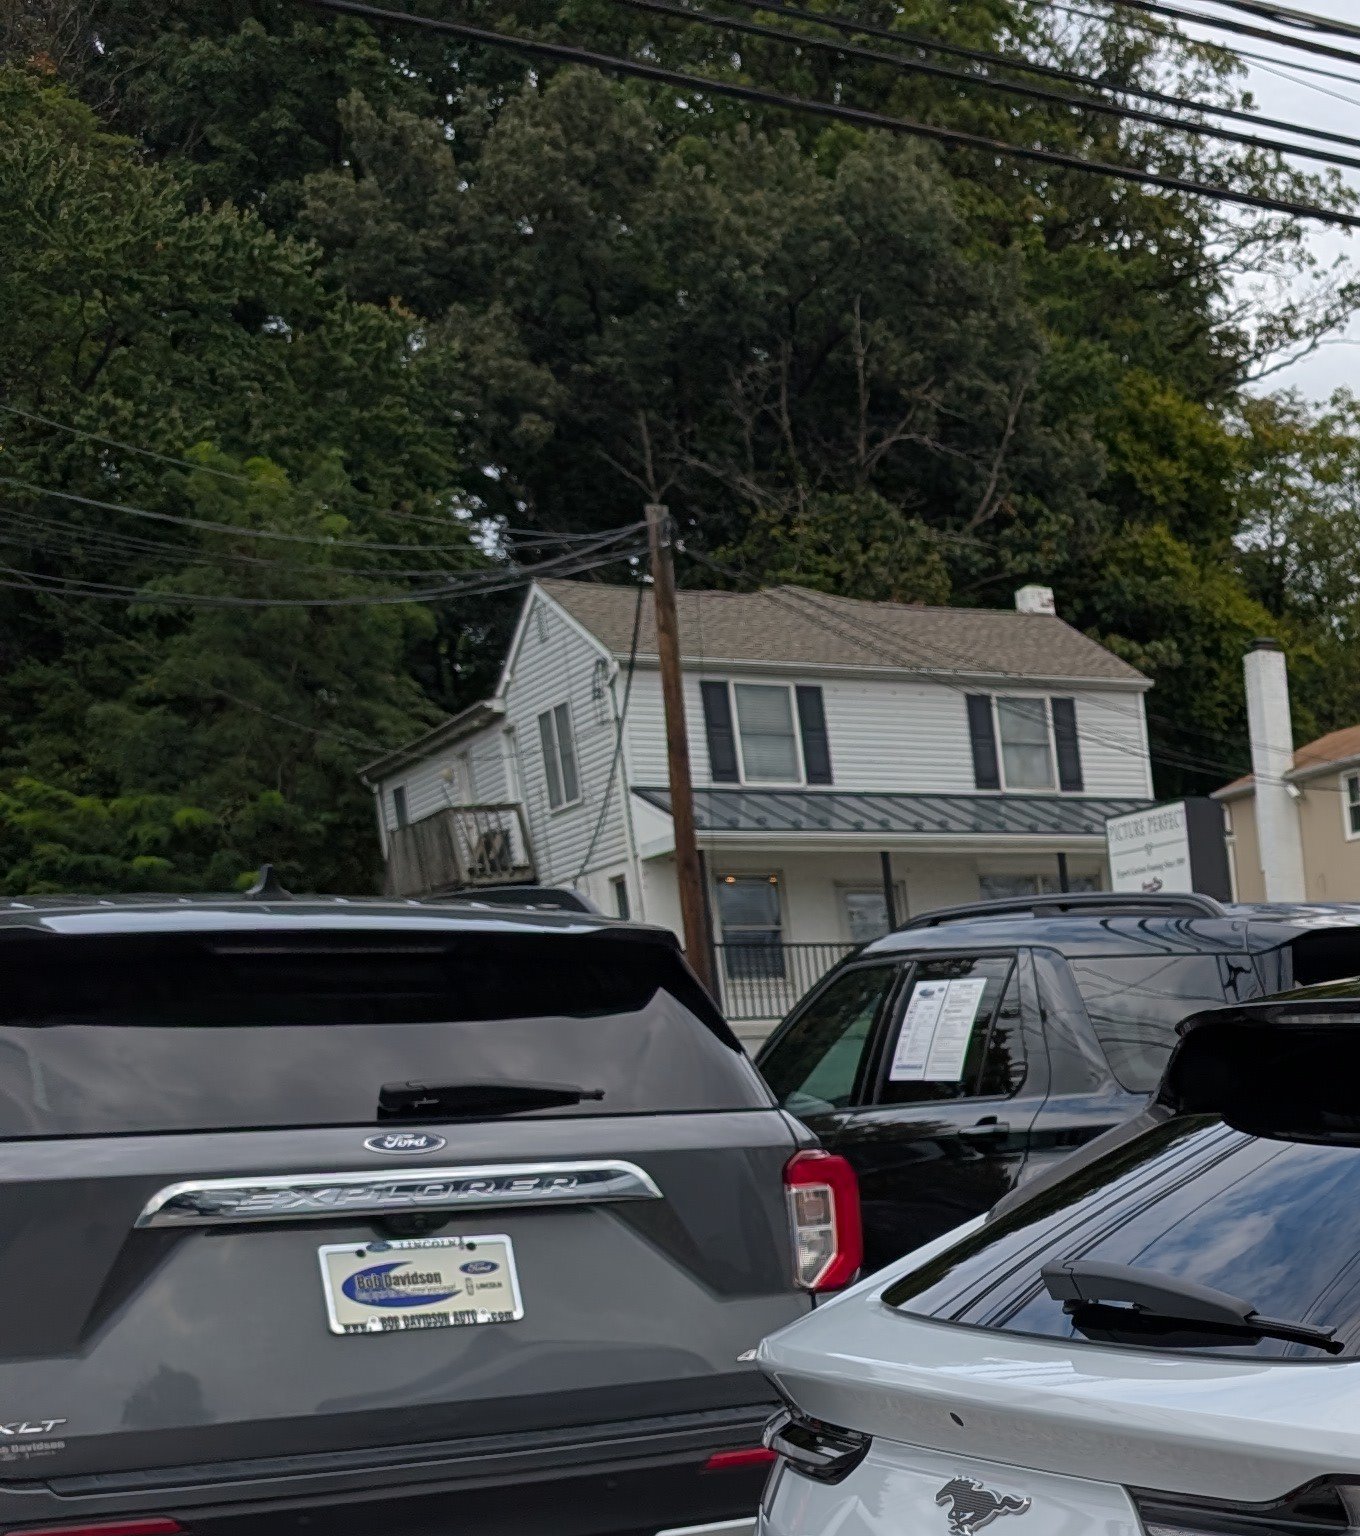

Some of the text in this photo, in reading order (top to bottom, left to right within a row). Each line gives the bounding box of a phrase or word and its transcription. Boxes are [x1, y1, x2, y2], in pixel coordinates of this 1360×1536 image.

[232, 1175, 580, 1212] EXPLORER
[356, 1270, 442, 1290] Bob Davidson
